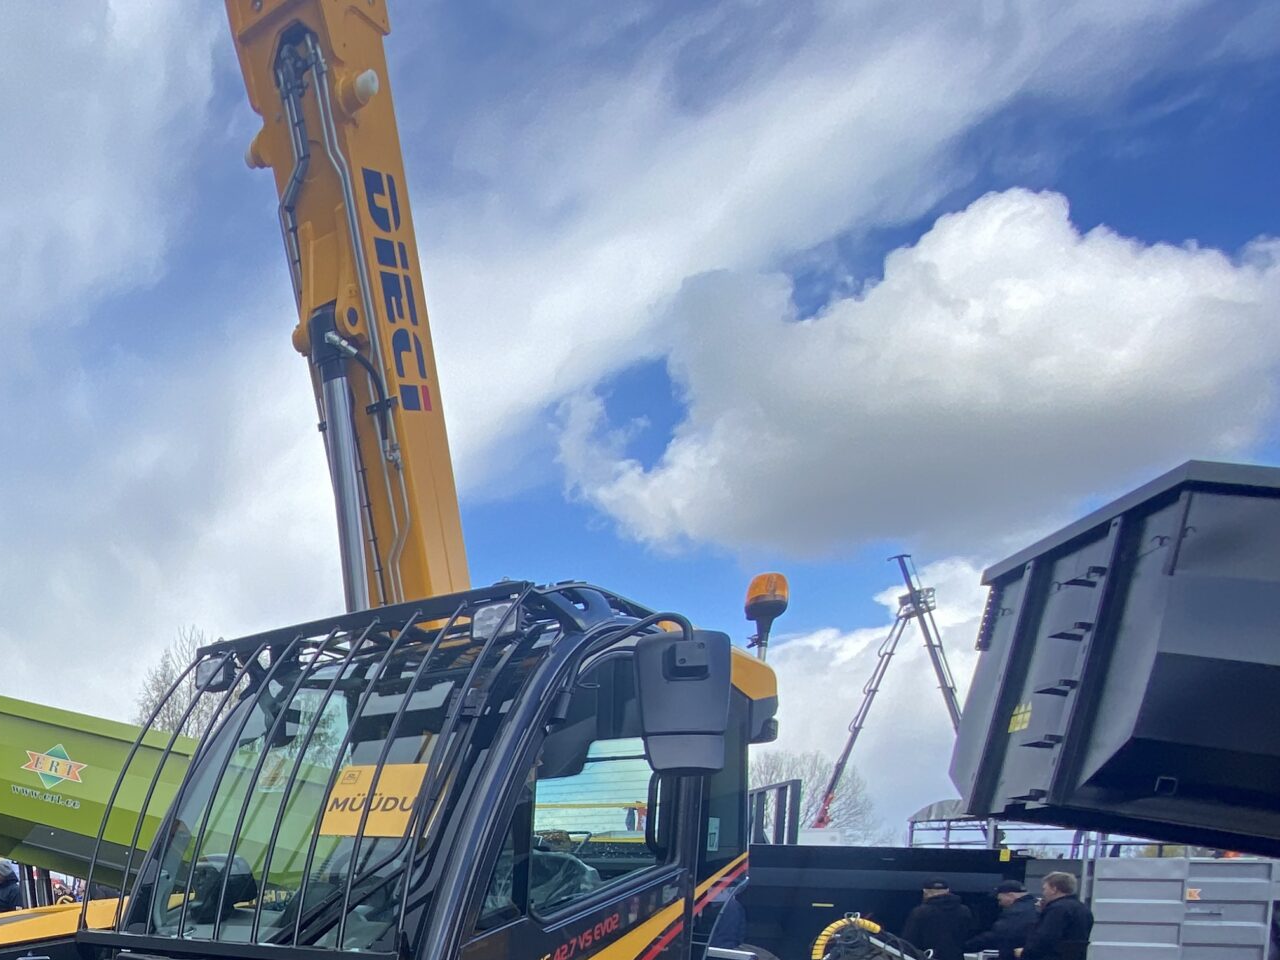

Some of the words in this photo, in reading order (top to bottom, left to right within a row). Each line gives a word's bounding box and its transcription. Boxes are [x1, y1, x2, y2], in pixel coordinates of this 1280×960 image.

[34, 756, 74, 776] ERT
[11, 784, 81, 809] www.ert.ee
[578, 929, 594, 950] VS
